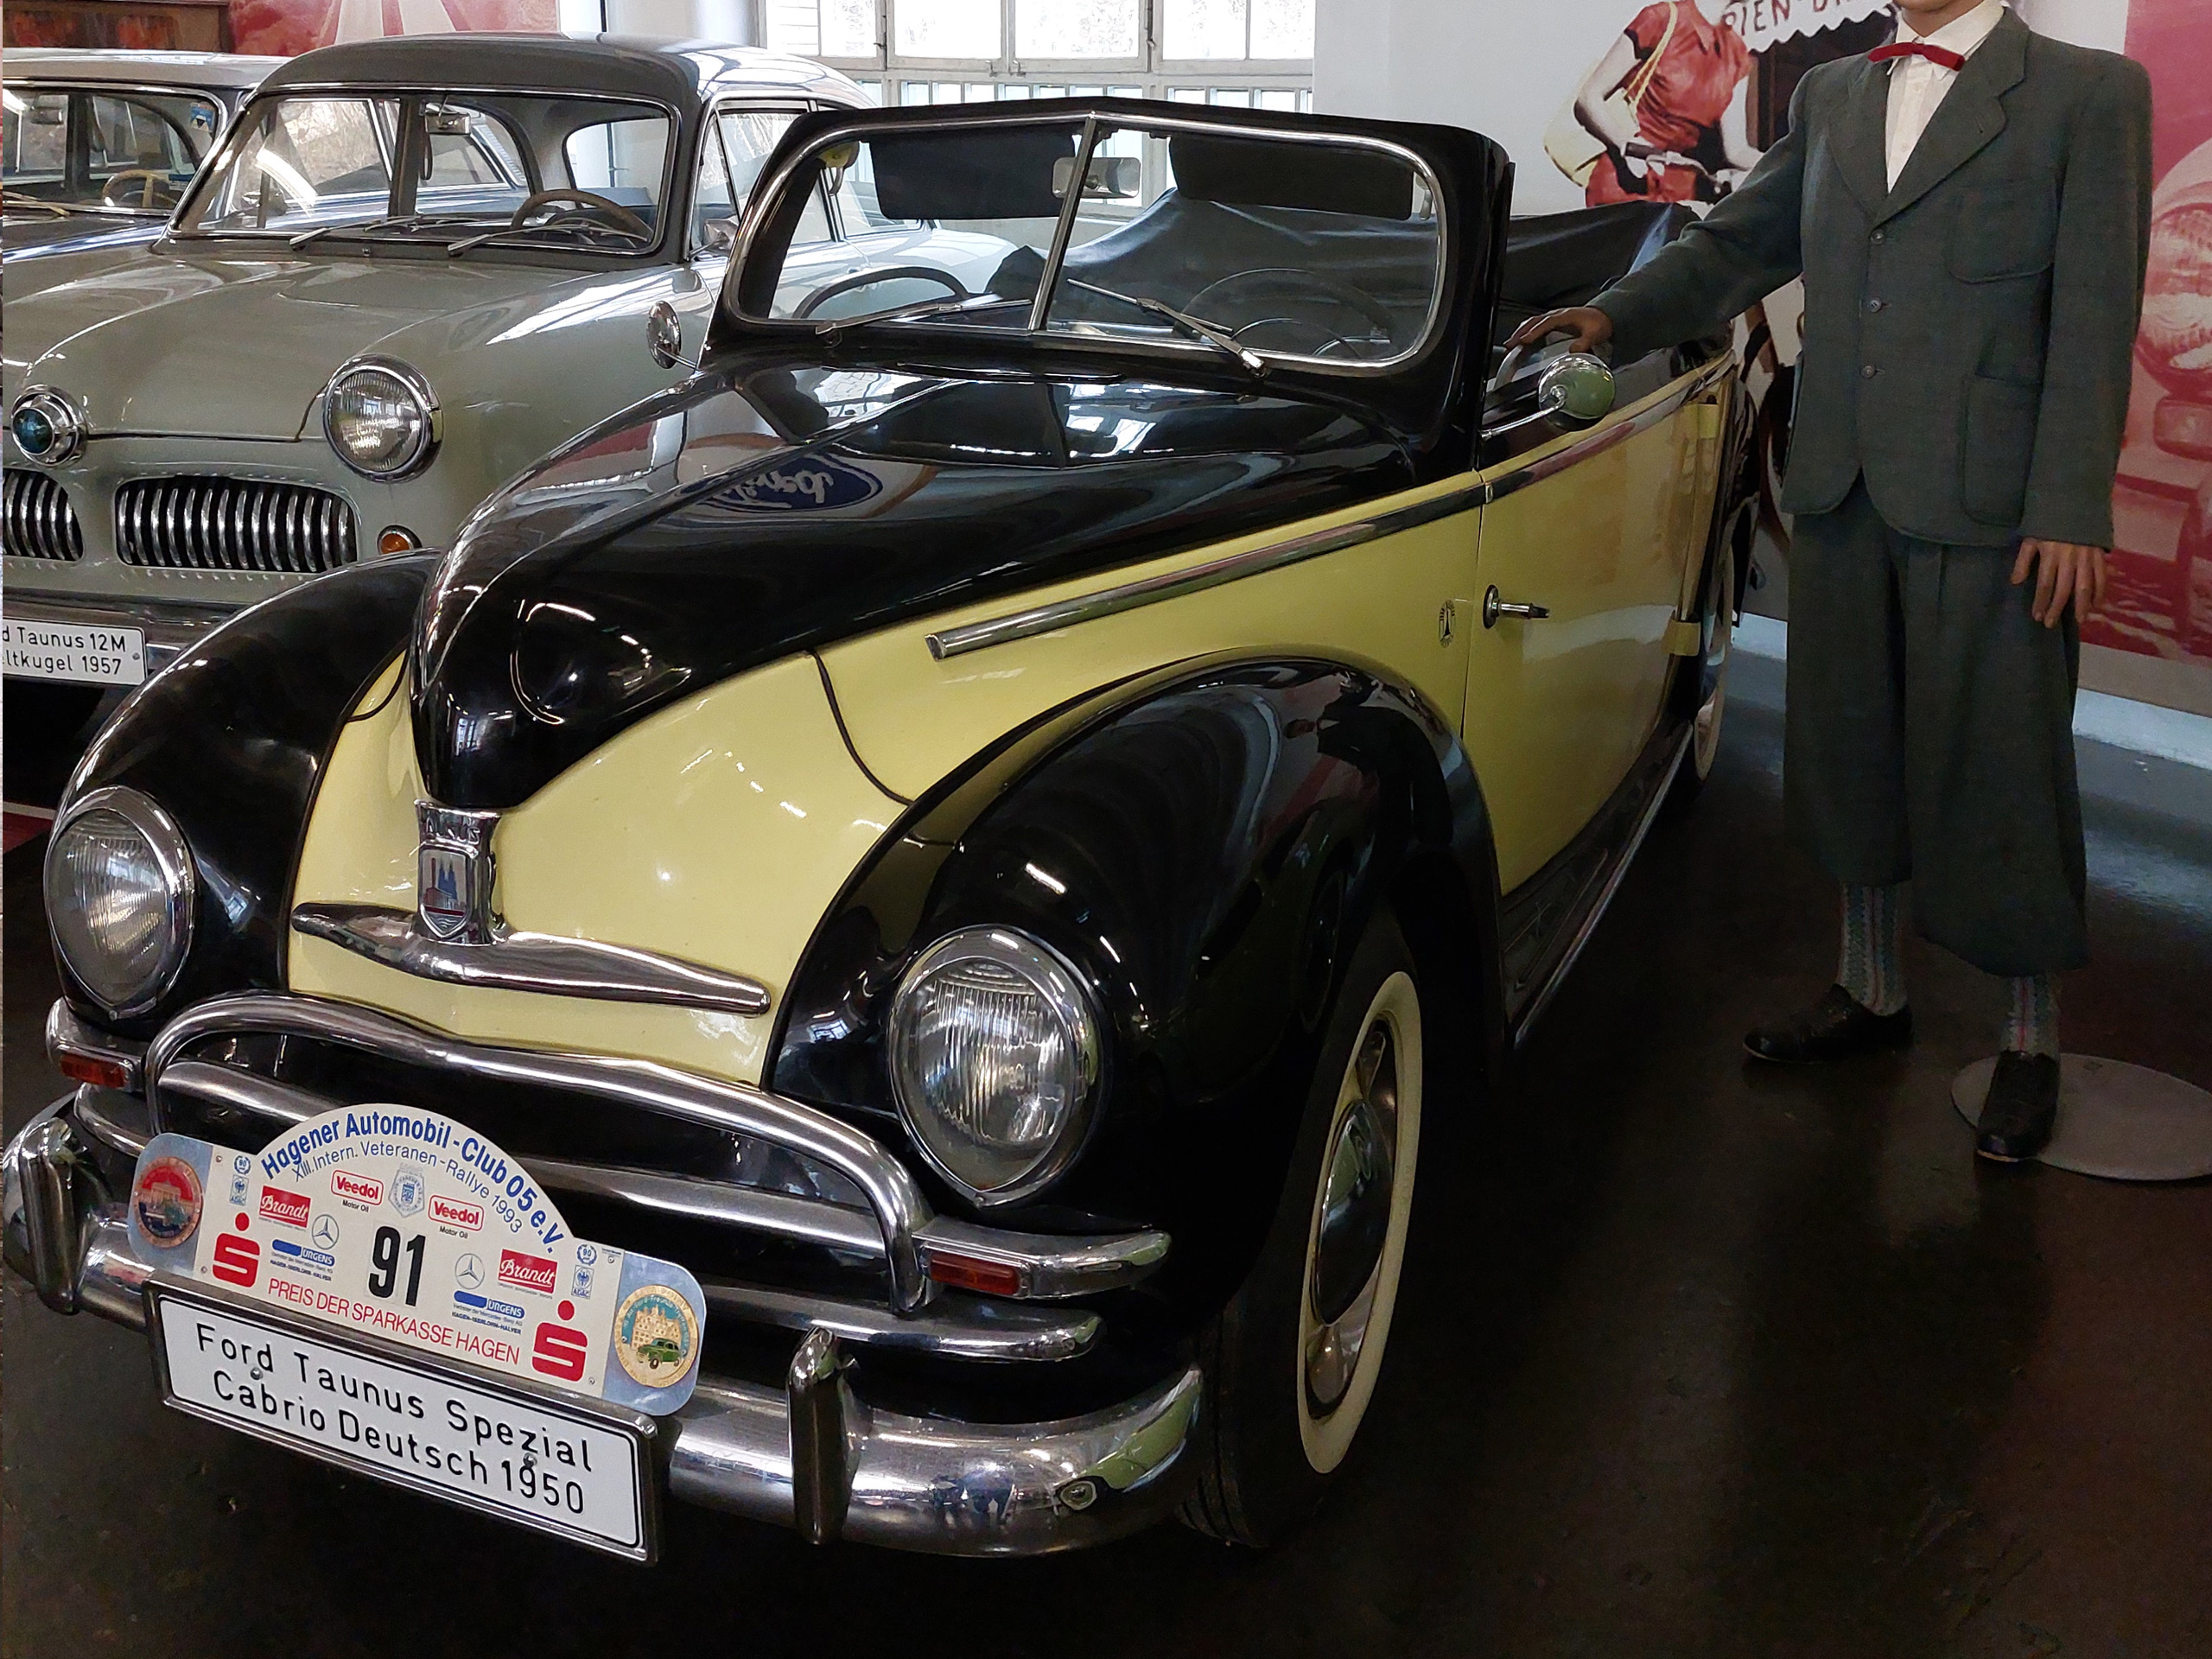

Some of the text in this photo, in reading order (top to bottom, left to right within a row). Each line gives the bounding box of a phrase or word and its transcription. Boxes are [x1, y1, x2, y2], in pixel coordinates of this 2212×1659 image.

[16, 626, 85, 649] Taunus
[90, 632, 126, 652] 12M
[3, 649, 122, 675] ltkugel 1957
[261, 1120, 340, 1180] Hagener
[506, 1175, 538, 1211] 05
[531, 1210, 565, 1254] e.V.
[337, 1175, 378, 1200] Veedol
[260, 1195, 309, 1220] Brandt
[342, 1199, 359, 1211] Motor
[434, 1201, 480, 1225] Veedol
[492, 1194, 523, 1233] 1993
[439, 1225, 468, 1239] Motor Oil
[368, 1225, 426, 1307] 91
[499, 1259, 556, 1287] Brandt
[268, 1279, 520, 1365] PREIS DER SPARKASSE HAGEN
[196, 1323, 593, 1472] Ford Taunus Spezial
[213, 1370, 585, 1515] Cabrio Deutsch 1950
